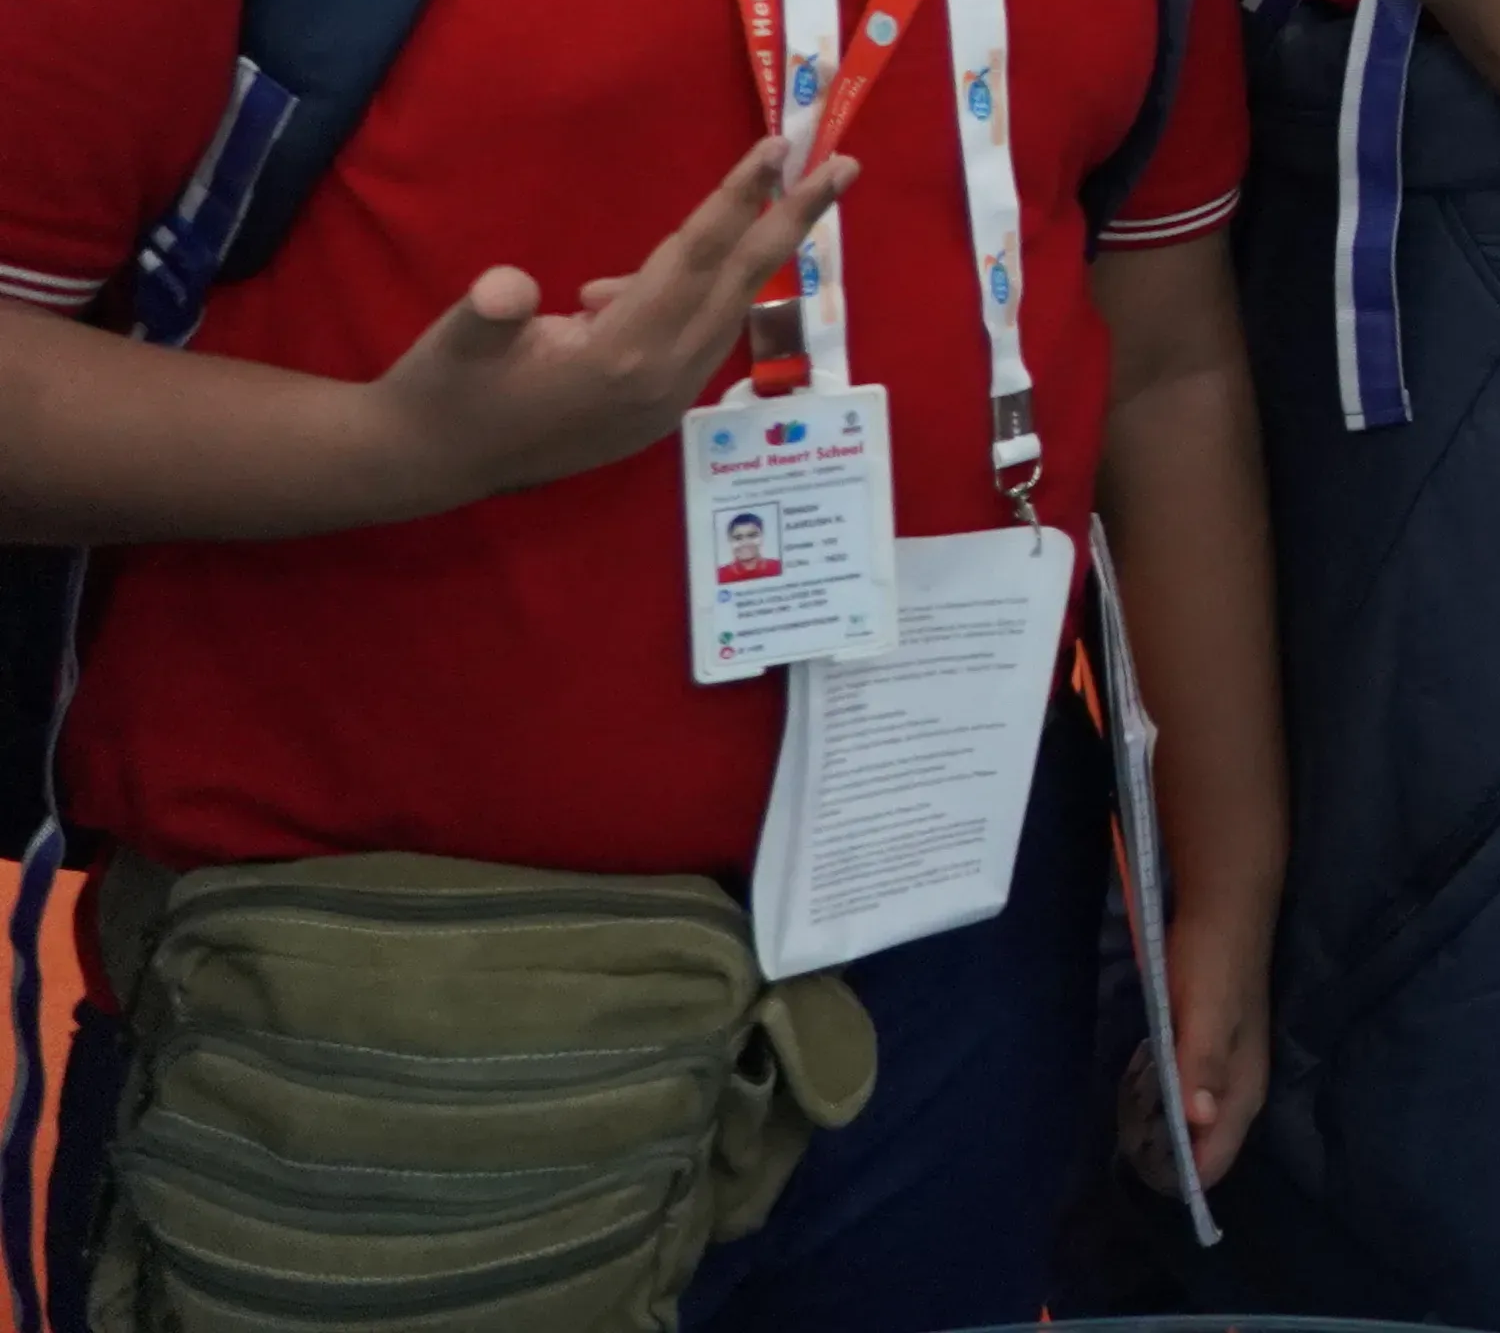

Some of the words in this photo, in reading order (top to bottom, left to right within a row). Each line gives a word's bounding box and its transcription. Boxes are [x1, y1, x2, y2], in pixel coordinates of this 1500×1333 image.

[710, 459, 761, 476] Sacred
[766, 450, 810, 467] Heart
[816, 442, 864, 459] School
